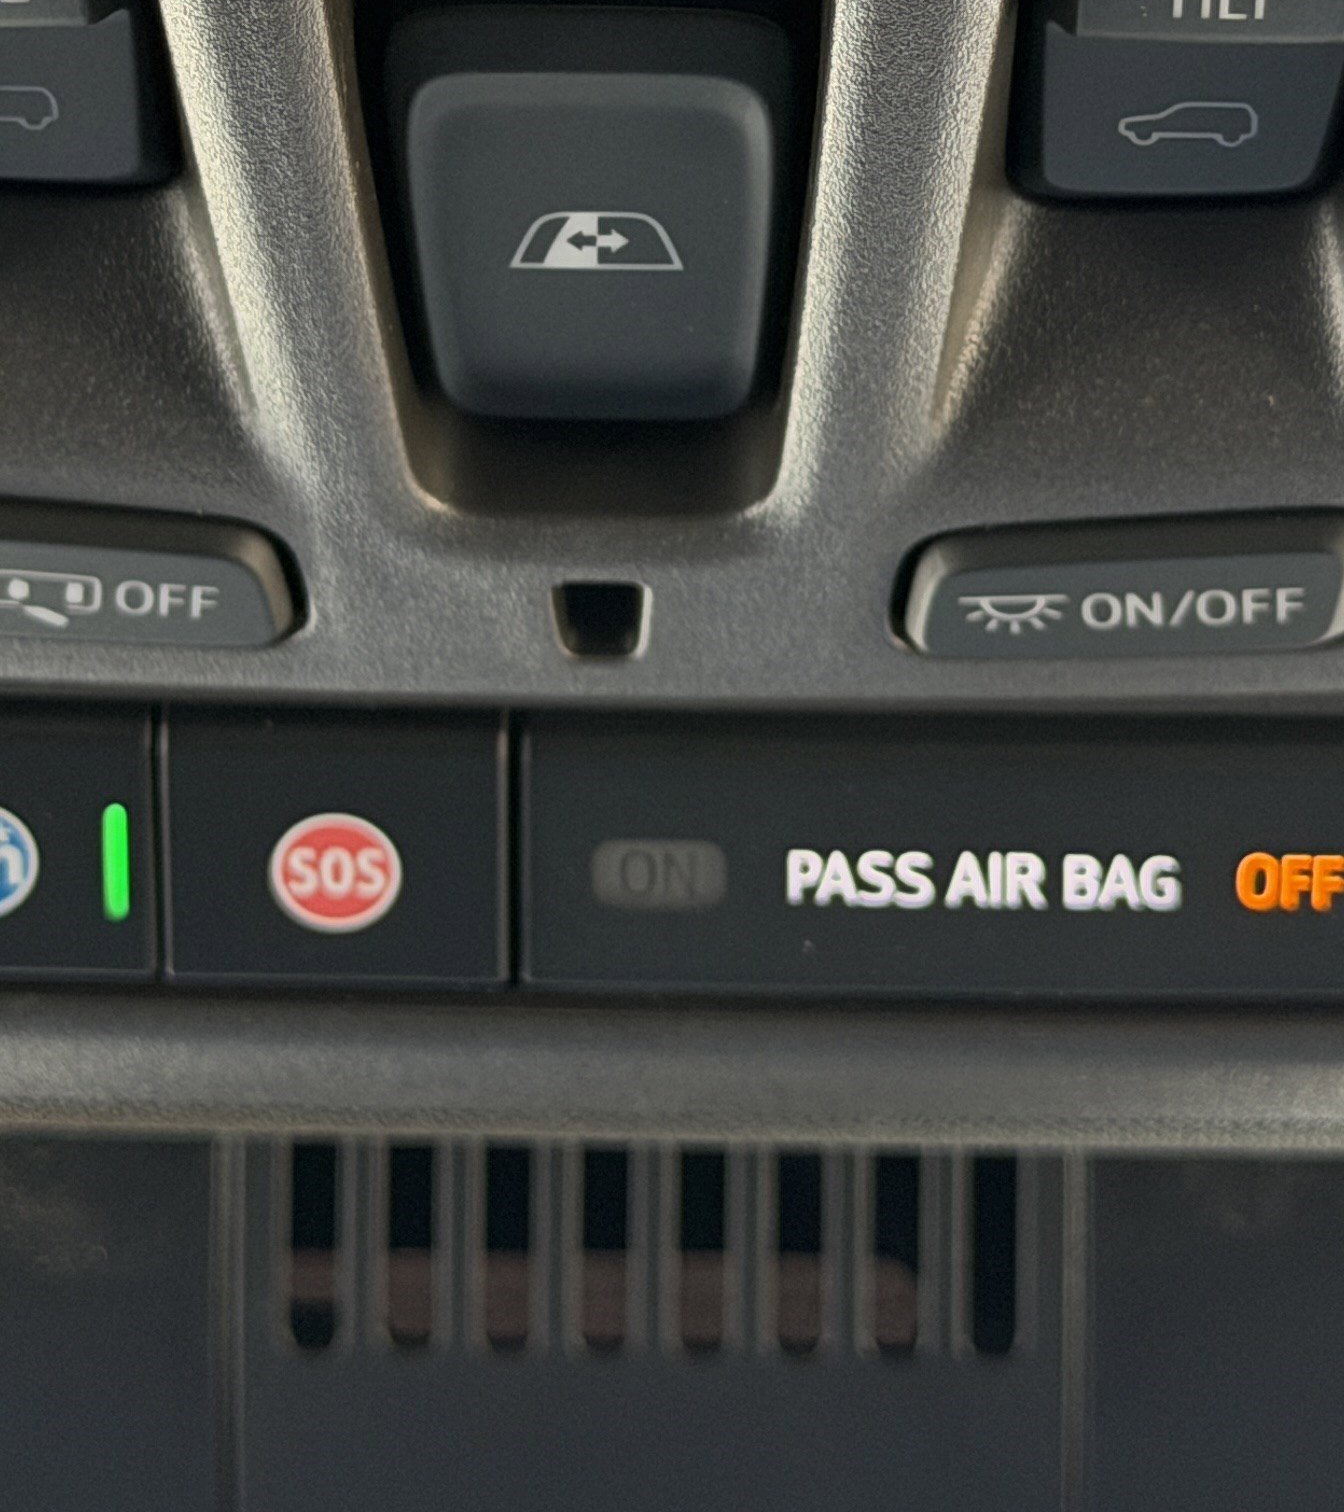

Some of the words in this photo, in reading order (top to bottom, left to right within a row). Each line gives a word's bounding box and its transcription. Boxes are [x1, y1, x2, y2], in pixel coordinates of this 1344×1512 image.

[114, 580, 221, 620] OFF
[1080, 586, 1306, 632] ON/OFF
[285, 845, 387, 896] SOS
[618, 848, 699, 899] ON
[785, 849, 934, 910] PASS
[943, 851, 1046, 911] AIR
[1062, 853, 1182, 913] BAG
